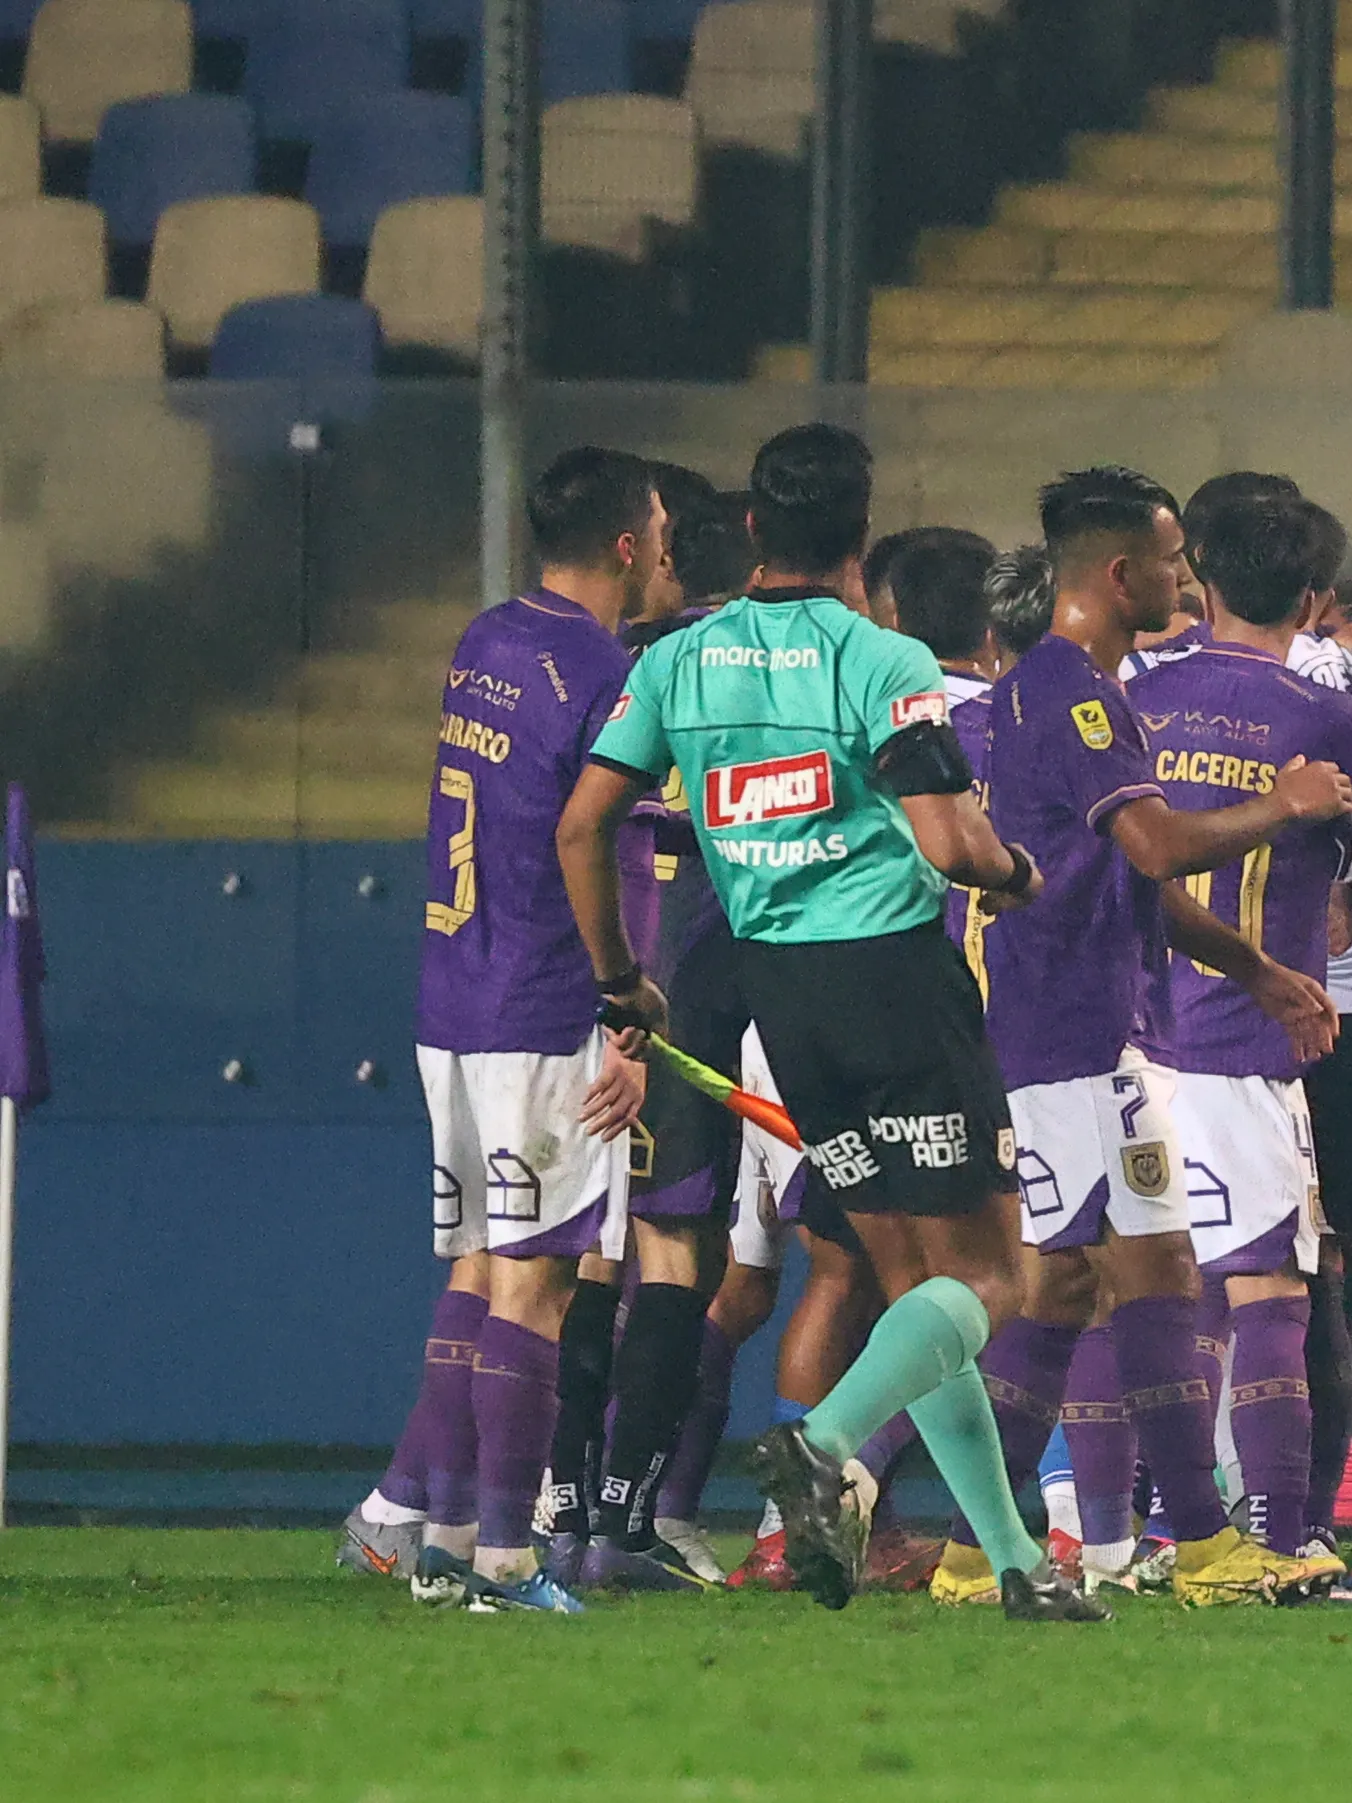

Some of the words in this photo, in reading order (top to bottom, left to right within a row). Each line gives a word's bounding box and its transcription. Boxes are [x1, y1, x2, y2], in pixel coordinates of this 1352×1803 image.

[1156, 749, 1279, 796] CACERES
[717, 766, 818, 829] LANCO
[868, 1112, 967, 1144] POWER
[1111, 1074, 1150, 1139] 7
[822, 1150, 882, 1190] ADE
[912, 1137, 971, 1169] ADE
